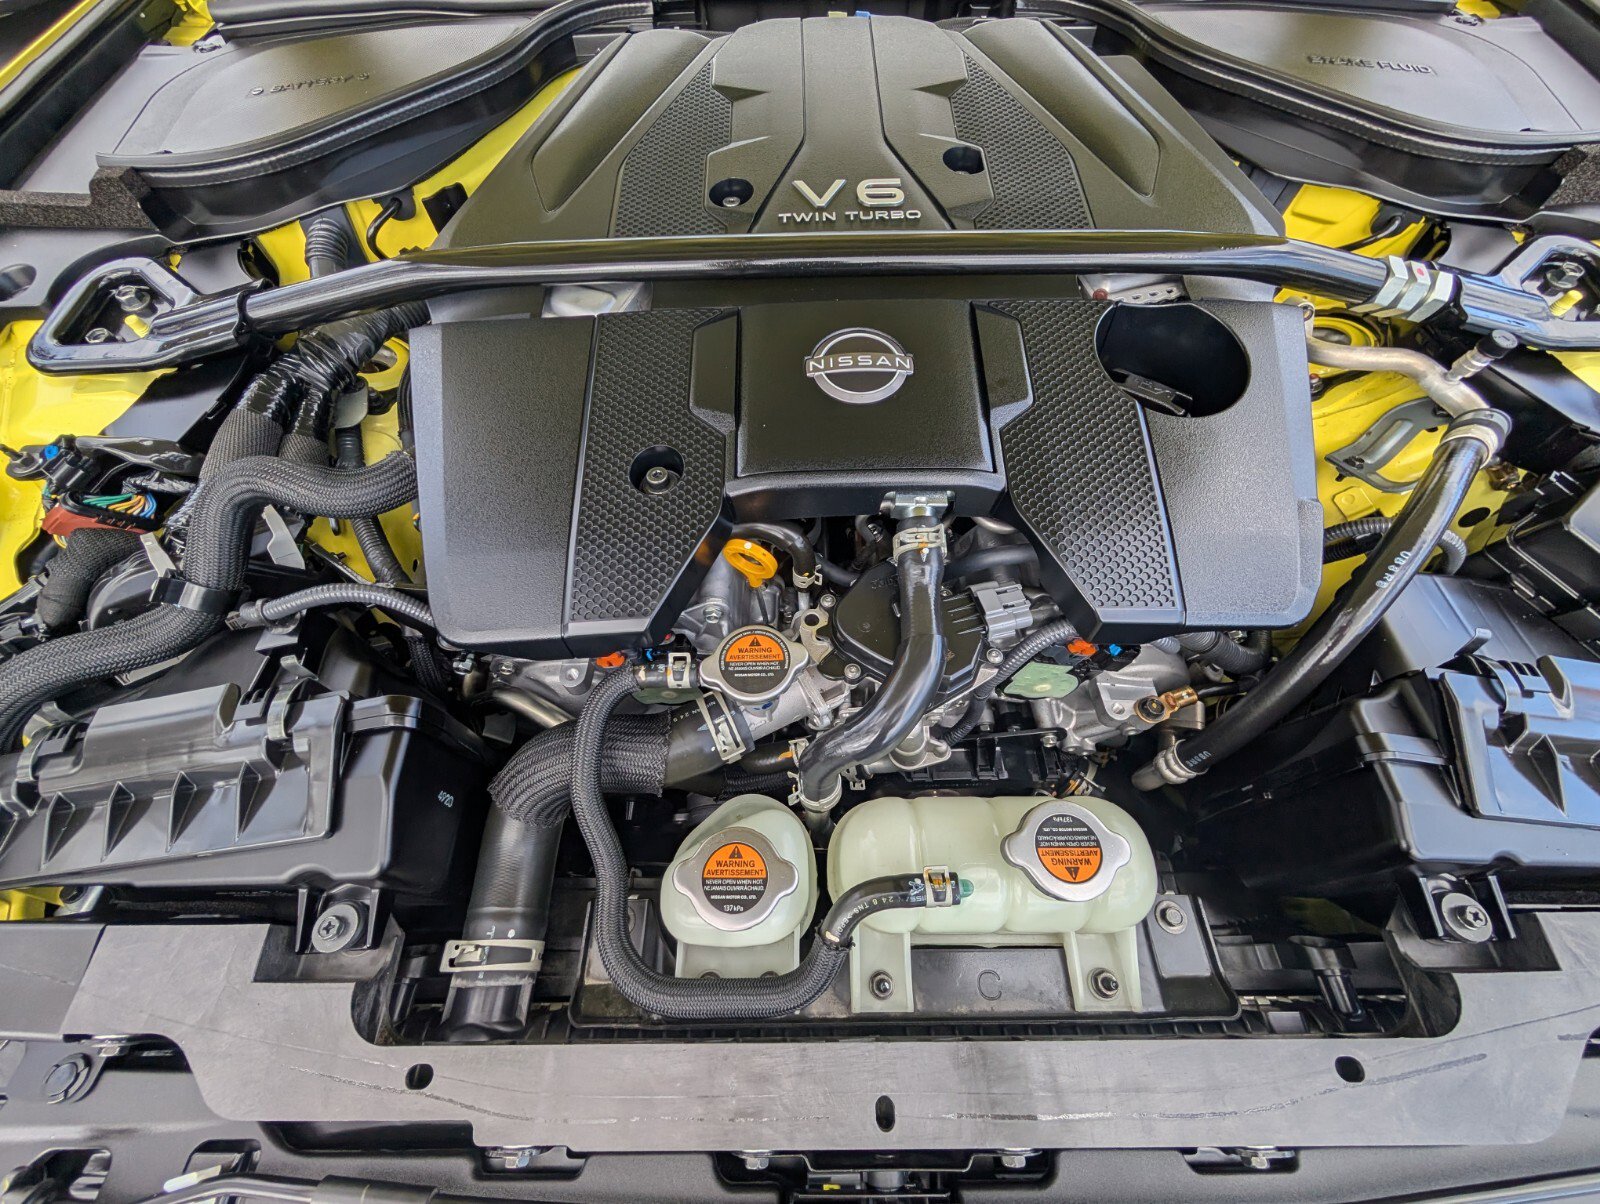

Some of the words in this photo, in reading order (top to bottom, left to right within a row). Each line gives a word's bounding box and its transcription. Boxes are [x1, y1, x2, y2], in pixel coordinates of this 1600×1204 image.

[1376, 60, 1433, 74] FLUID
[778, 211, 837, 224] TWIN
[844, 209, 922, 221] TURBO
[809, 355, 911, 371] NISSAN
[737, 646, 773, 654] WARNING
[1041, 849, 1098, 857] AVERTISSEMENT
[715, 860, 756, 868] WARNING
[1051, 857, 1092, 866] WARNING
[733, 904, 744, 912] kPa
[977, 969, 1003, 1001] C
